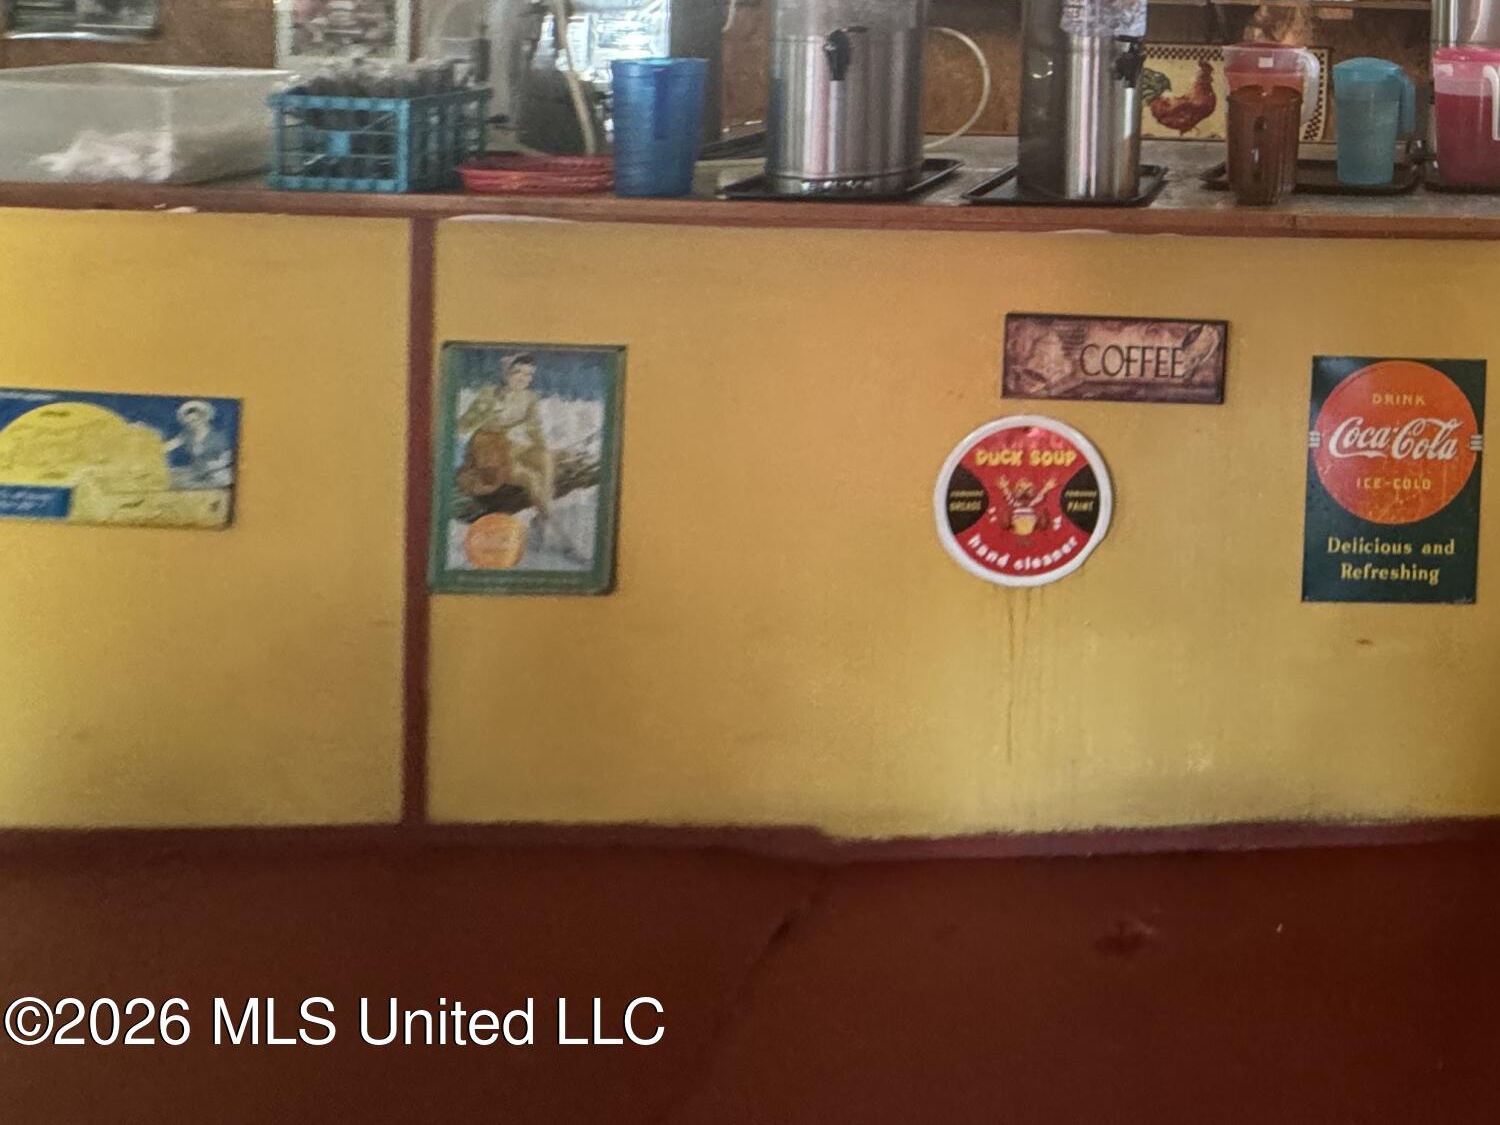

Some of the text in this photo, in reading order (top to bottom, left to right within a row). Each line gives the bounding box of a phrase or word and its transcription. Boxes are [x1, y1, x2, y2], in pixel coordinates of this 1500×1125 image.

[1080, 343, 1186, 379] COFFEE
[1372, 393, 1426, 406] DRINK
[1328, 416, 1463, 460] Coca-Cola
[975, 448, 1078, 467] DUCK SOUP
[1356, 477, 1432, 490] ICE-COLD
[967, 534, 1010, 568] hand
[1327, 536, 1455, 555] Delicious and
[1340, 562, 1440, 586] Refreshing
